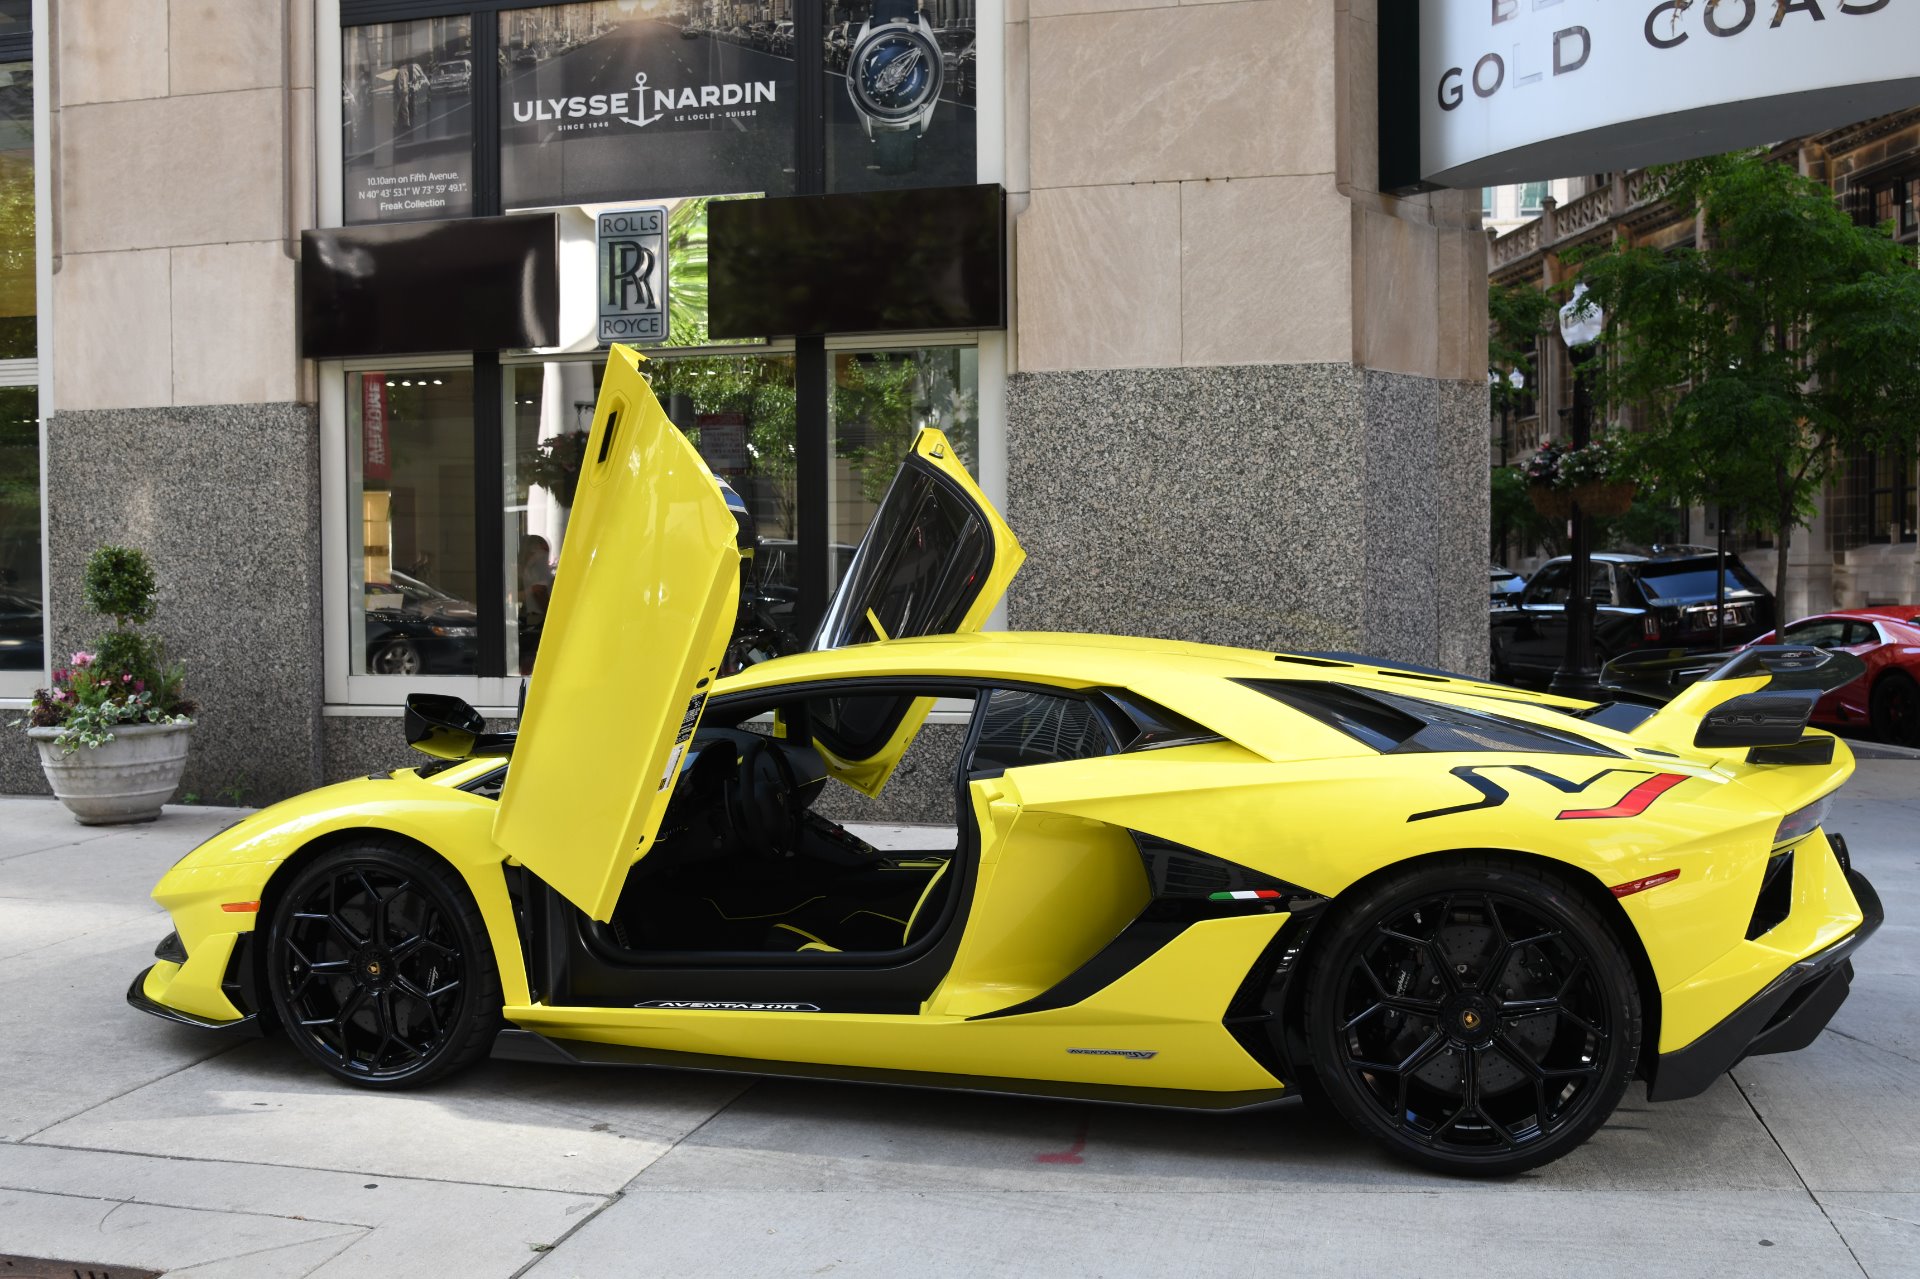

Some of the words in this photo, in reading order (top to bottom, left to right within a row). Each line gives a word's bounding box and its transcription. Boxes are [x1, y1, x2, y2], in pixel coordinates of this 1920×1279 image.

[1437, 26, 1592, 112] GOLD
[513, 92, 629, 122] ULYSSE
[653, 80, 776, 111] NARDIN
[688, 112, 715, 121] LOCLE
[725, 109, 757, 118] SUISSE
[558, 122, 585, 132] SINCE
[367, 176, 397, 186] 10.10am
[397, 176, 408, 184] on
[409, 173, 427, 183] Fifth
[428, 172, 459, 181] Avenue.
[358, 191, 365, 200] N
[411, 187, 421, 196] W
[380, 202, 403, 211] Freak
[404, 199, 446, 209] Collection
[603, 215, 658, 233] ROLLS
[604, 318, 659, 334] ROYCE
[658, 1002, 800, 1010] AVENTADOR
